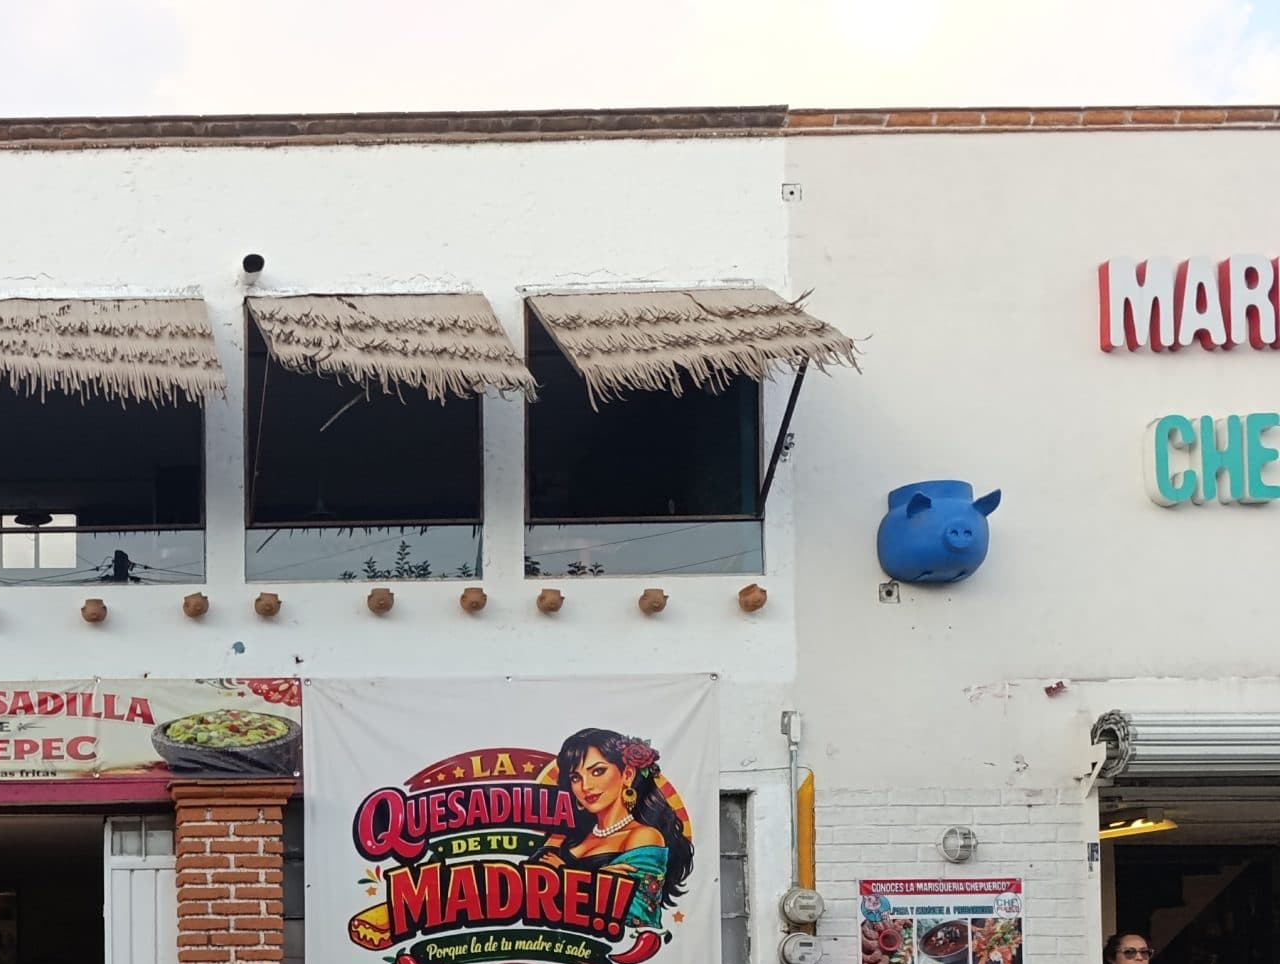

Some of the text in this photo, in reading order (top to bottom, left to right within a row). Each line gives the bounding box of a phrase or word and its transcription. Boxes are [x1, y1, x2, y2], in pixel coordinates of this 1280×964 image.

[1147, 413, 1280, 505] CHE
[19, 769, 57, 778] fritas
[469, 753, 517, 778] LA
[356, 787, 576, 858] QUESADILLA
[452, 835, 518, 854] DE TU
[871, 882, 904, 893] CONOCES
[906, 882, 915, 892] LA
[917, 882, 964, 892] MARISQUERIA
[389, 864, 634, 936] MADRE!!
[997, 898, 1018, 906] CHE
[426, 936, 592, 960] Porque la de tu madre sí sabe
